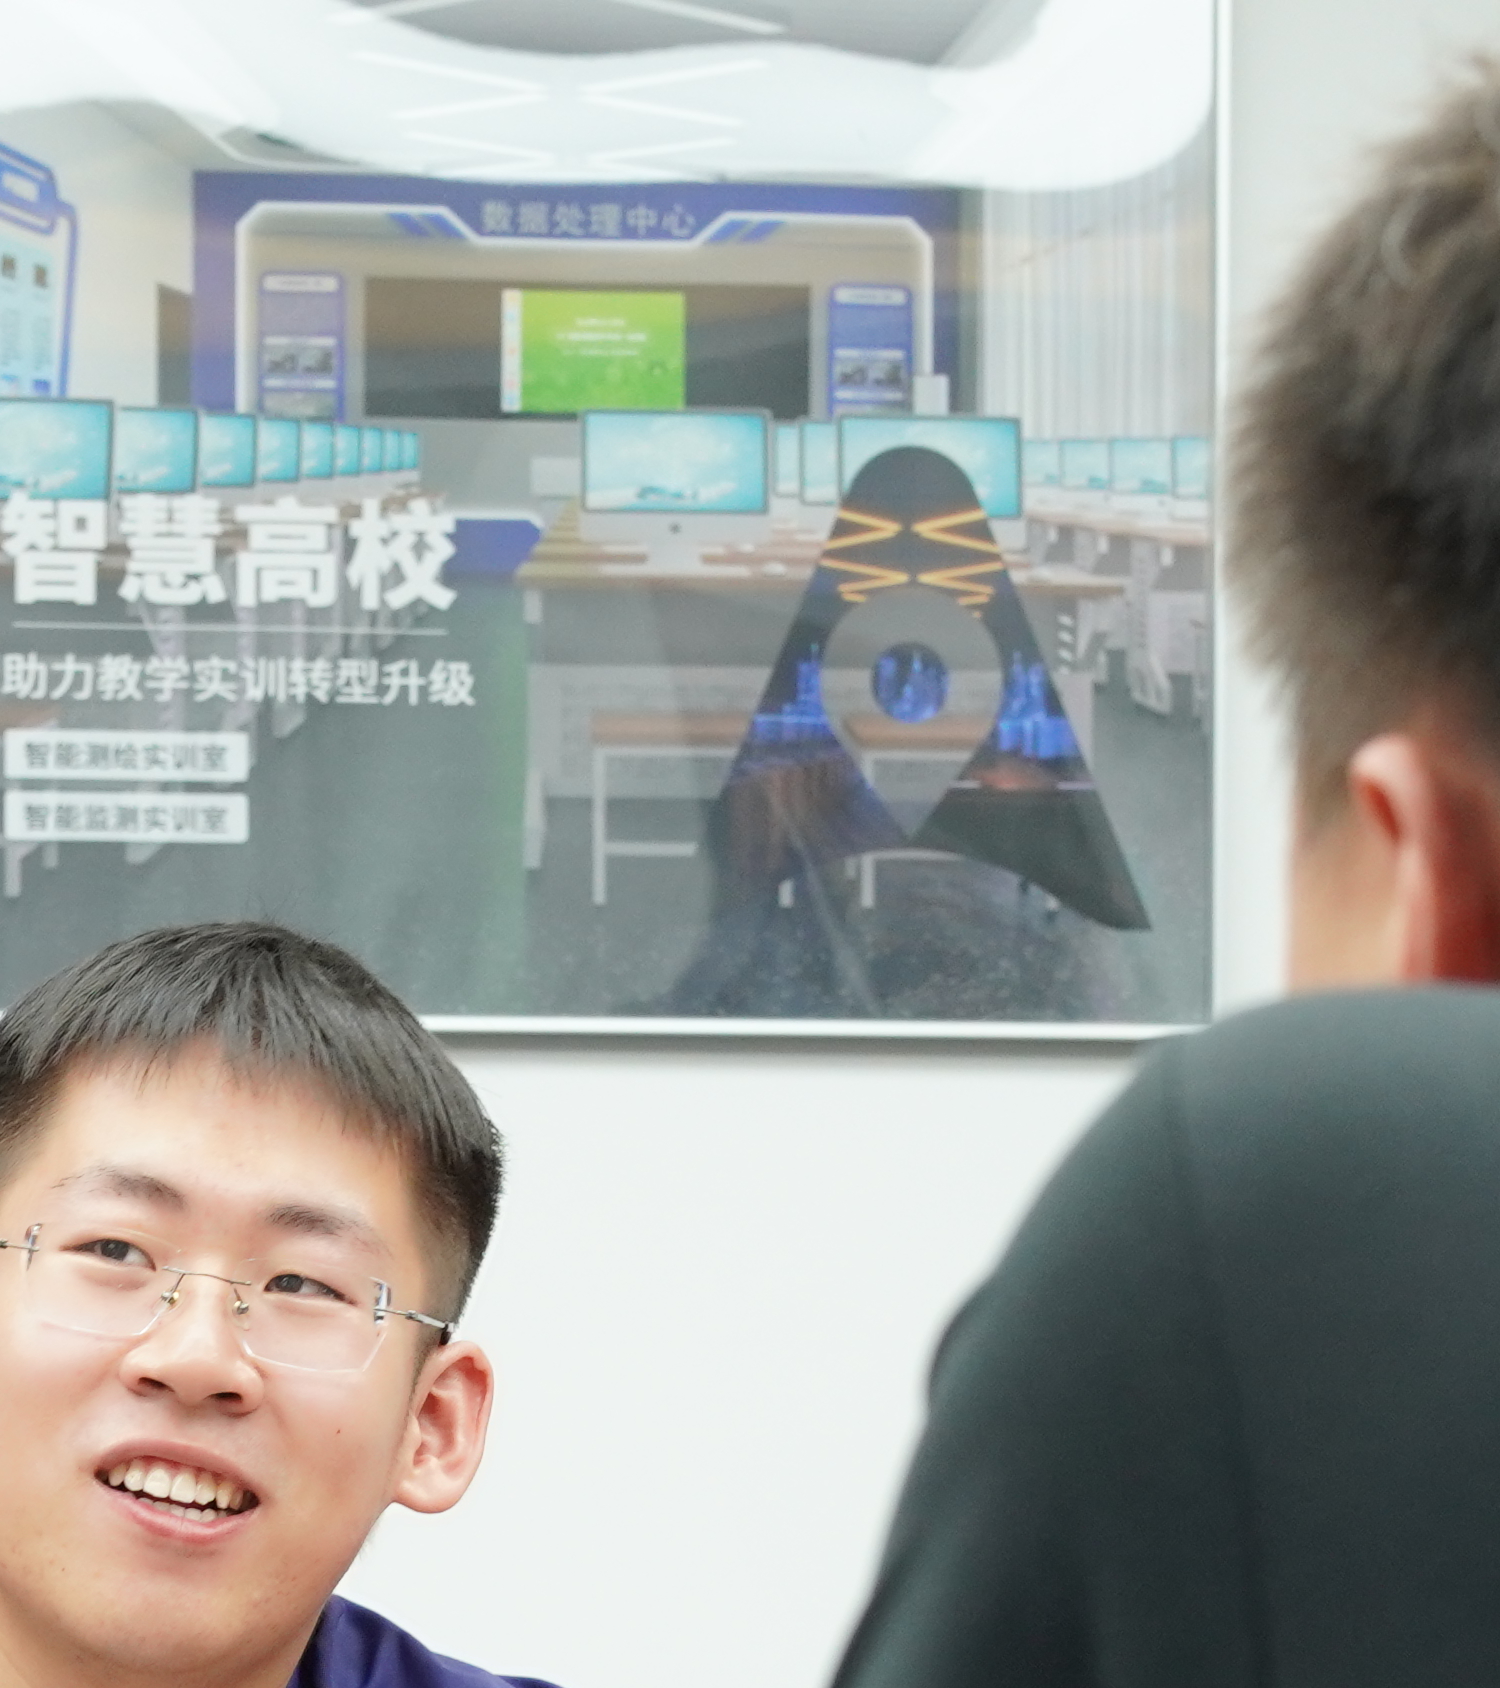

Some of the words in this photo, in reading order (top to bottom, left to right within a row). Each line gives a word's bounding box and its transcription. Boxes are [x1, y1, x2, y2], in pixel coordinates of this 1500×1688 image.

[480, 199, 698, 237] 数据处理中心
[1, 490, 458, 611] 智慧高校
[1, 653, 476, 706] 助力教学实训转型升级
[24, 741, 229, 772] 智能测绘实训室
[24, 803, 229, 834] 智能监测实训室
